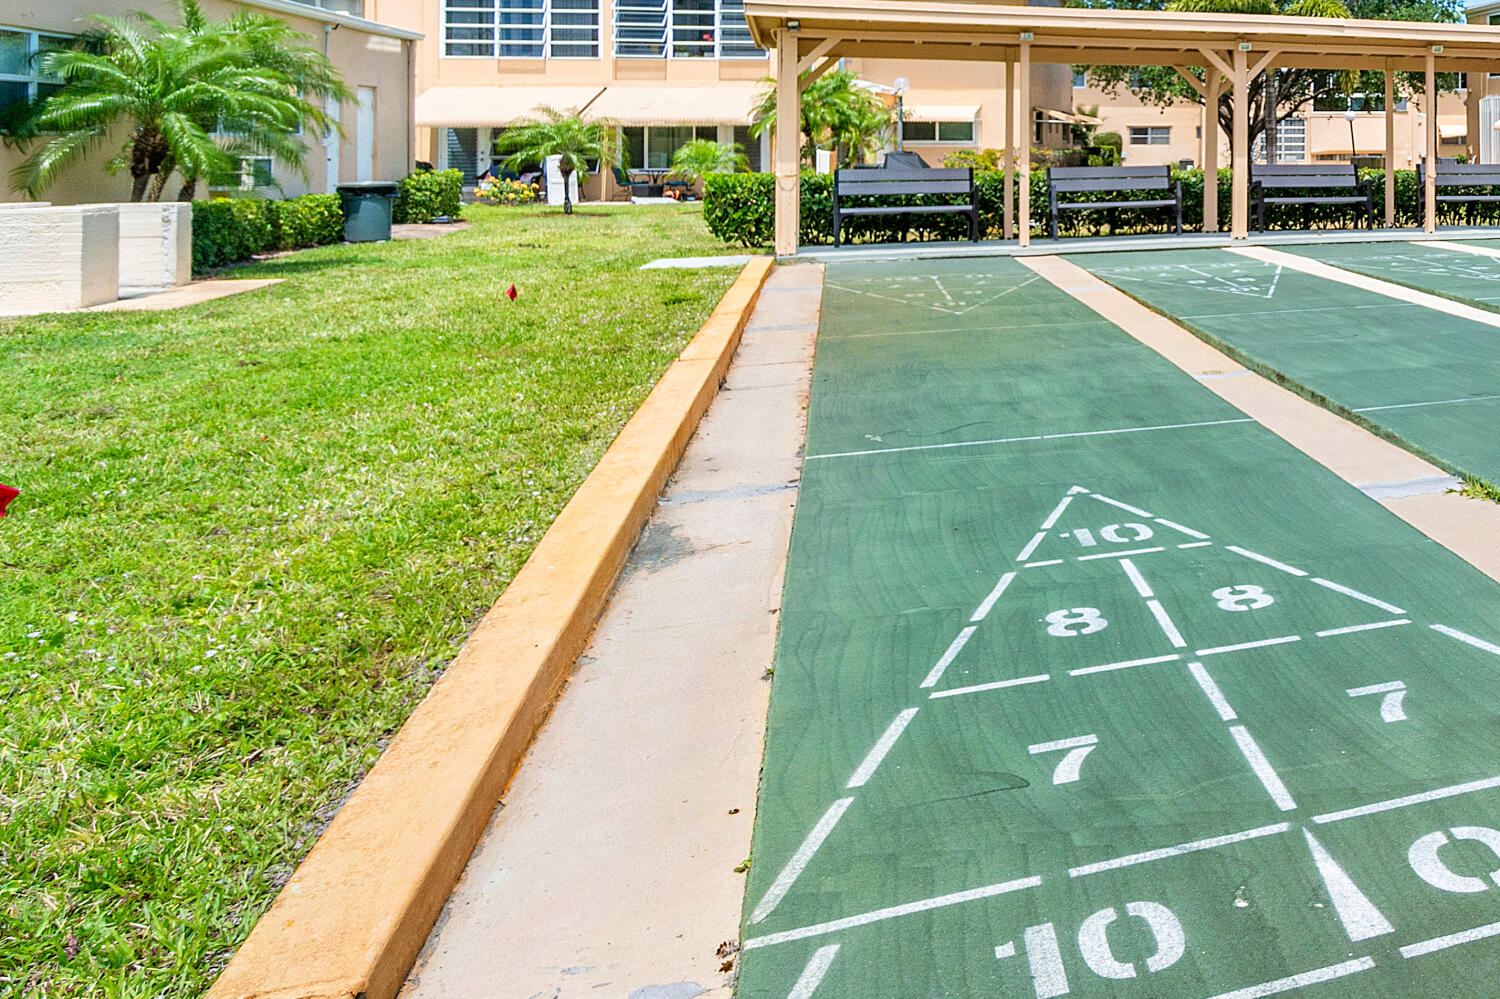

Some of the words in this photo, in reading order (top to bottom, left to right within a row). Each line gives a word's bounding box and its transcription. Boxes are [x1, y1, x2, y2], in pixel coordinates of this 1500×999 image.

[1059, 523, 1154, 547] 10
[1211, 585, 1275, 611] 8
[1045, 607, 1108, 637] 8
[1345, 680, 1411, 723] 7
[1028, 734, 1099, 785] 7
[994, 901, 1186, 999] 10
